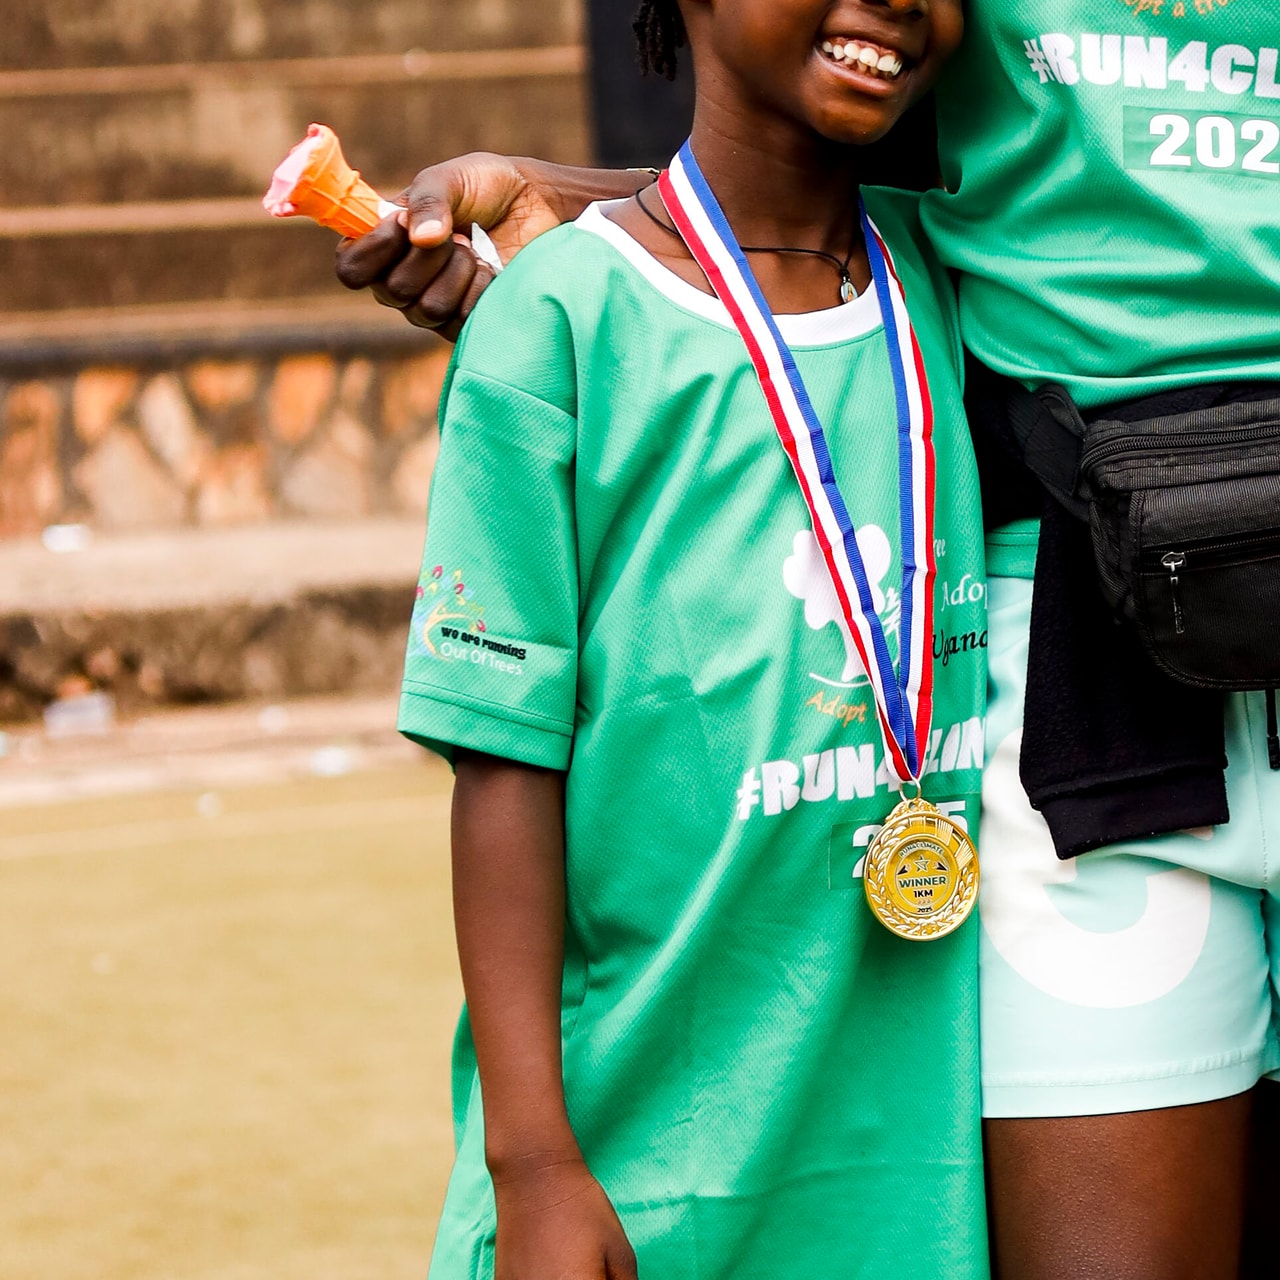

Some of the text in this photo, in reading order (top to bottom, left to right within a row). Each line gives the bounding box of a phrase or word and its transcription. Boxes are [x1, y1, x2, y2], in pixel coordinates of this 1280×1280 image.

[1173, 1, 1185, 18] a
[440, 641, 467, 661] Out
[487, 652, 523, 676] Trees
[482, 638, 526, 661] running
[805, 690, 867, 729] Adopt
[899, 876, 946, 888] WINNER
